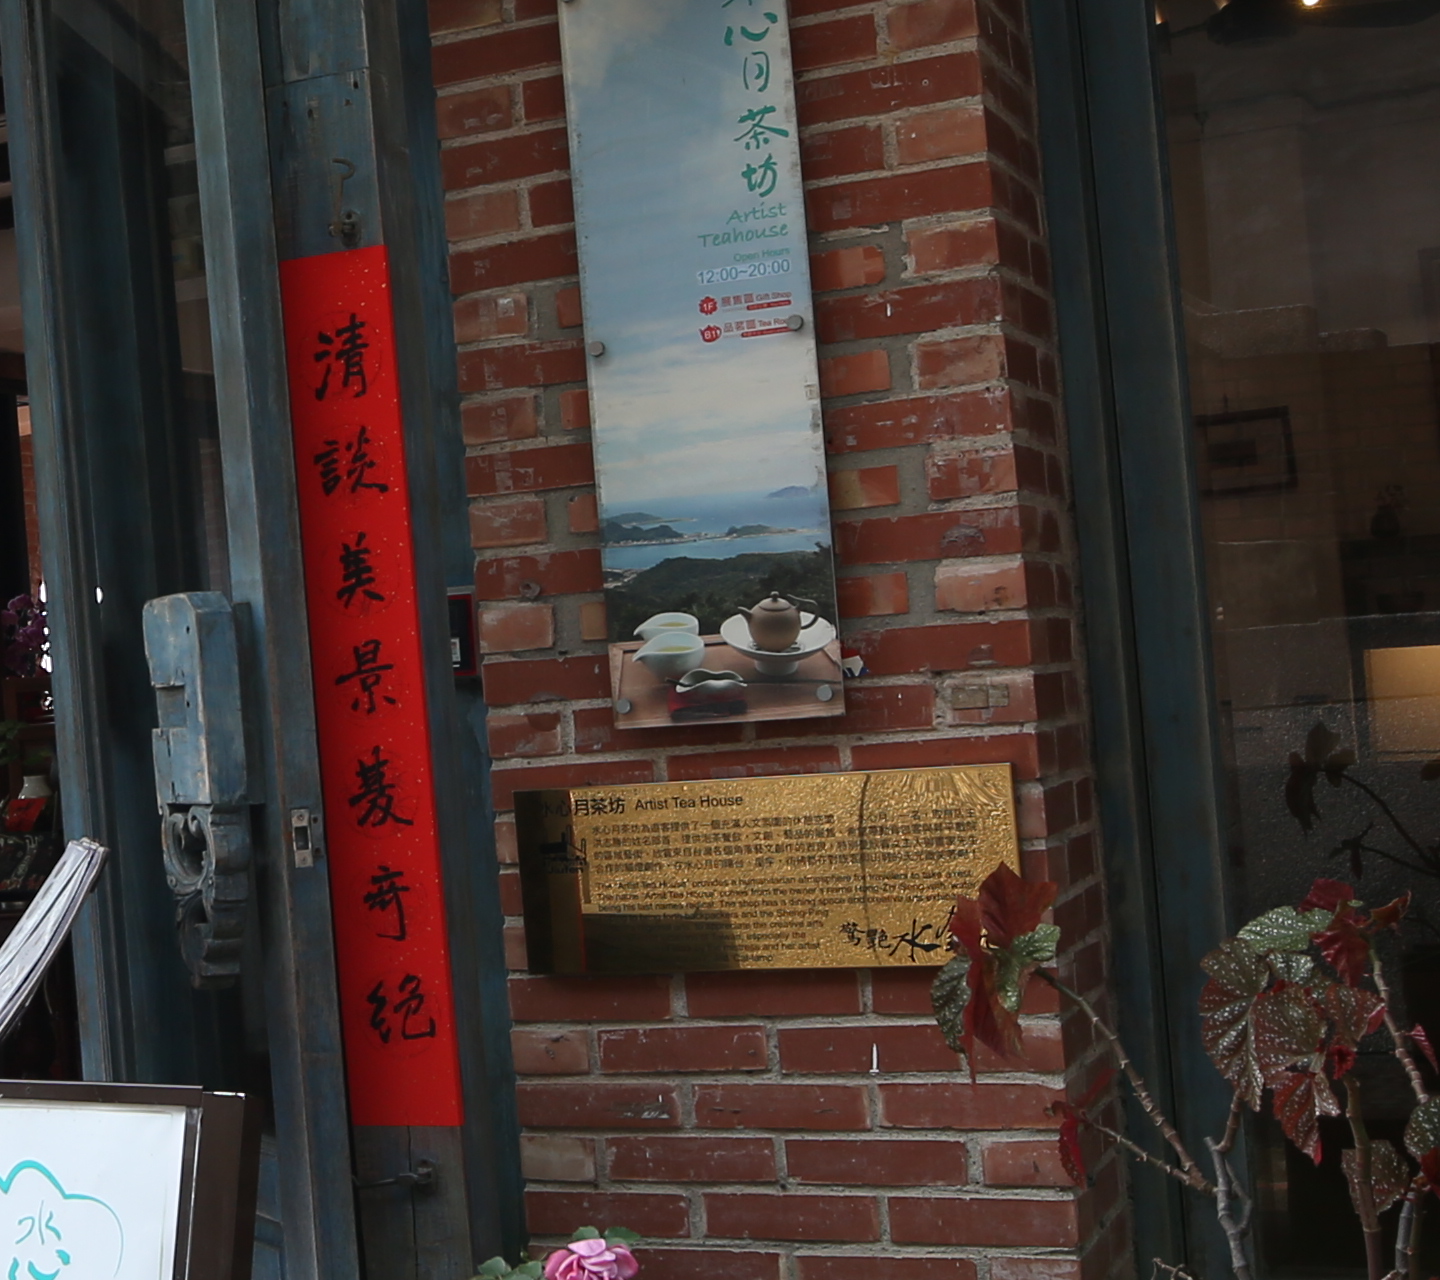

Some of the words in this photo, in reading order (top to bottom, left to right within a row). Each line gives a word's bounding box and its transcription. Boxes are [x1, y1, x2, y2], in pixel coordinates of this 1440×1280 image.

[726, 202, 787, 225] Artist
[698, 223, 789, 248] Teahouse
[733, 250, 760, 262] Open
[762, 247, 790, 258] Hours
[698, 259, 791, 284] 12:00~20:00
[635, 798, 668, 811] Artist
[672, 797, 696, 809] Tea
[700, 794, 744, 808] House
